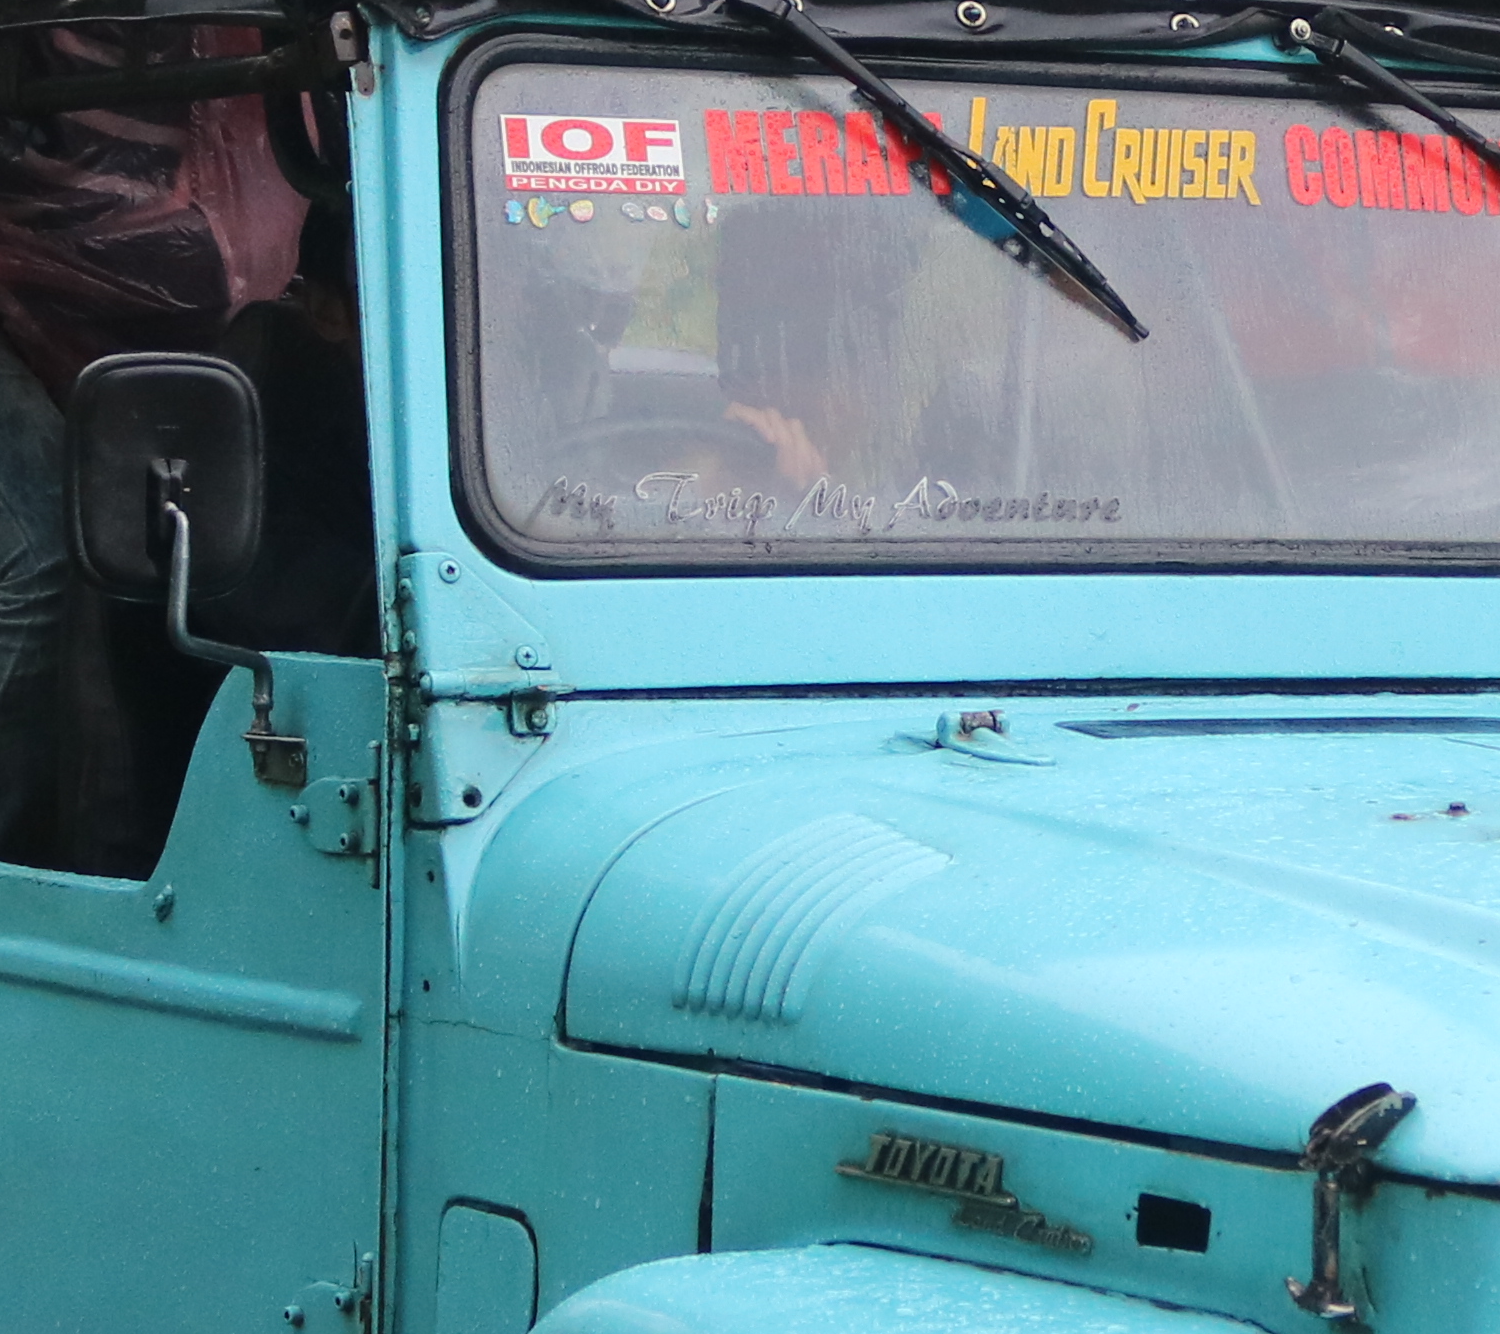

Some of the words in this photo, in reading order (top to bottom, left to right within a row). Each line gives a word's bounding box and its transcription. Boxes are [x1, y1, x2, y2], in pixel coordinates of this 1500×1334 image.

[504, 117, 677, 162] IOF
[1082, 98, 1262, 206] CRUISER
[511, 160, 571, 175] INDONESIAN
[574, 161, 619, 176] OFFROAD
[621, 163, 680, 177] FEDERATION
[511, 177, 628, 192] PENGDA
[635, 180, 679, 192] DIY
[635, 471, 778, 538] Trip
[784, 474, 876, 536] My
[866, 1131, 1004, 1196] TOYOTA
